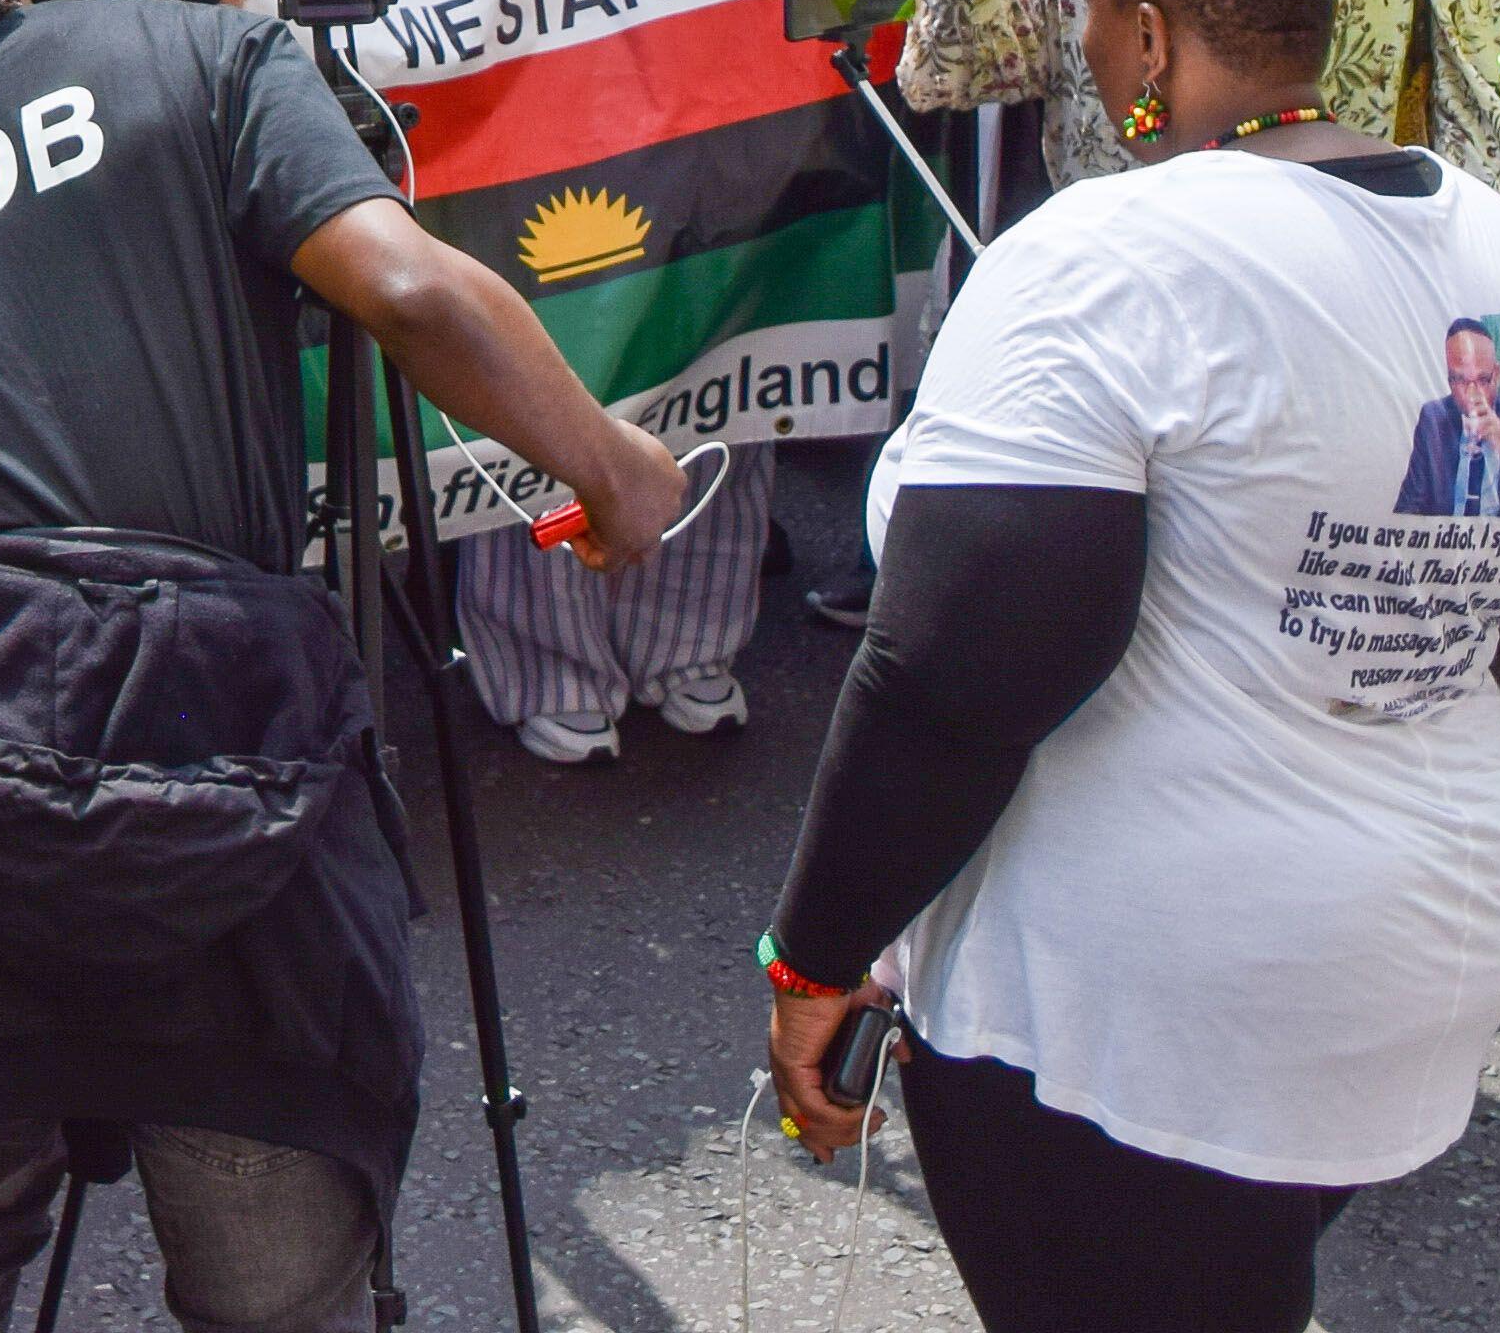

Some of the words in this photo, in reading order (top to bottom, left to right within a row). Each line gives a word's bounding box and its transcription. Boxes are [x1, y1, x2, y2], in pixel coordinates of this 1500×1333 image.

[634, 342, 890, 437] England
[1306, 510, 1328, 543] If
[1328, 523, 1369, 550] you
[1373, 525, 1405, 548] are
[1407, 530, 1430, 550] an
[1434, 523, 1476, 552] idiot,
[1480, 523, 1490, 549] I
[1296, 548, 1339, 577] like
[1340, 561, 1372, 579] an
[1419, 558, 1470, 587] That's
[1469, 558, 1498, 584] the
[1284, 586, 1328, 609] you
[1329, 592, 1371, 614] can
[1278, 607, 1304, 638] to
[1308, 614, 1346, 657] try
[1346, 625, 1366, 653] to
[1366, 633, 1441, 659] massage
[1349, 663, 1402, 689] reason
[1402, 663, 1446, 683] very
